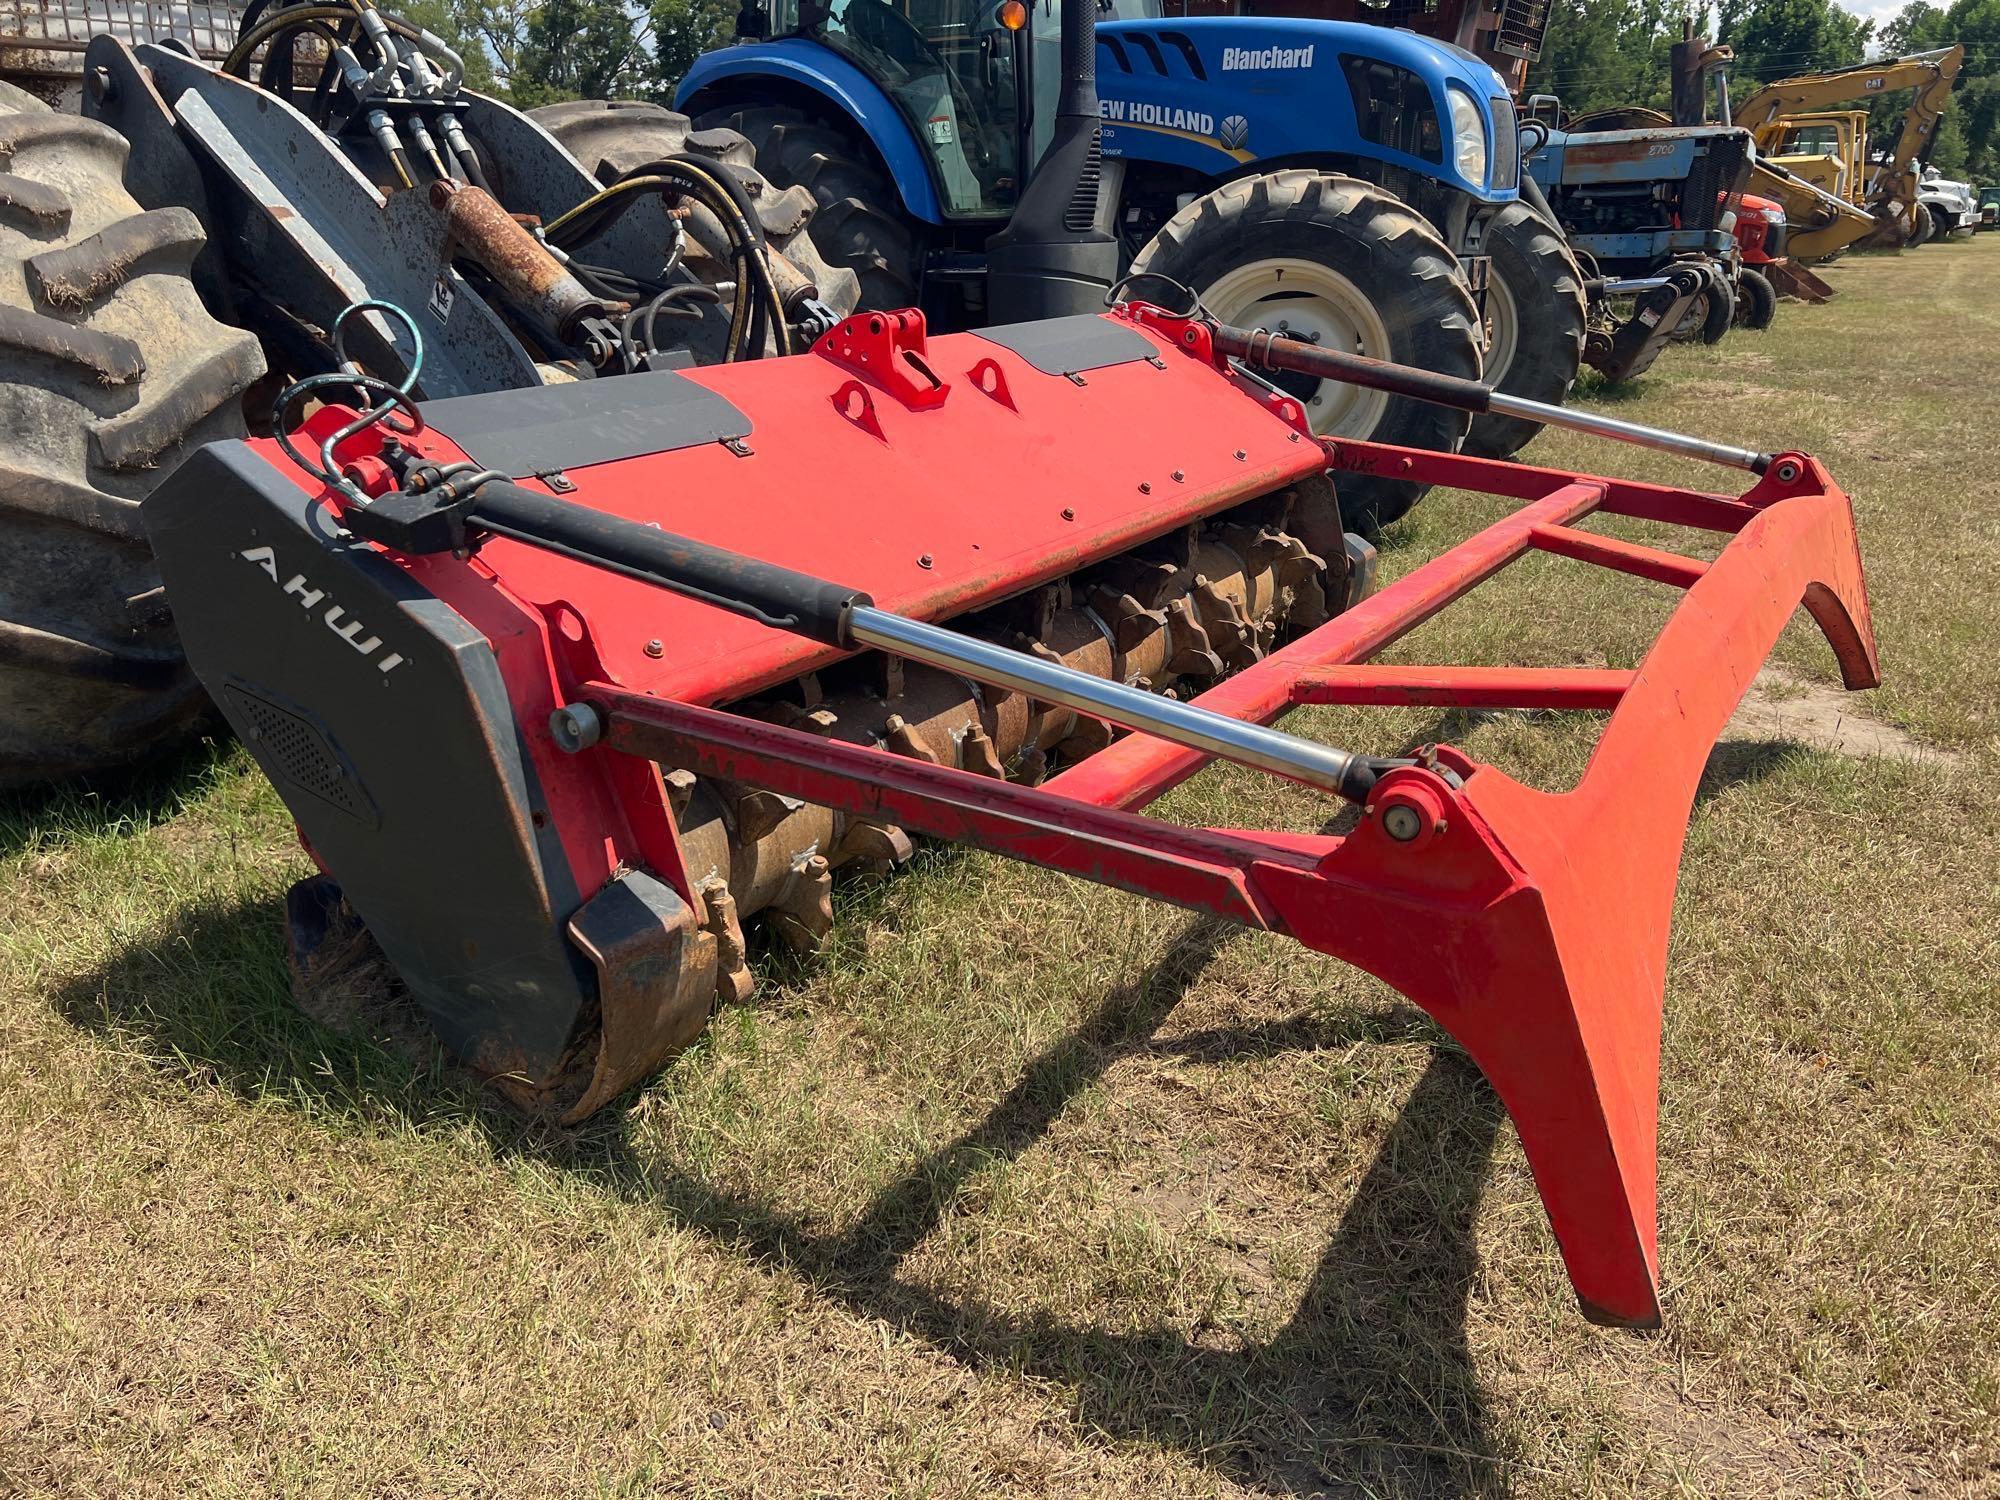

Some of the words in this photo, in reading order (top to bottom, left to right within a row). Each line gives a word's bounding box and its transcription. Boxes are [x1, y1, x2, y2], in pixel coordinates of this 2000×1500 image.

[1222, 44, 1315, 71] Blanchard
[1865, 79, 1882, 89] CAT
[1098, 99, 1125, 120] EW
[1129, 102, 1214, 135] HOLLAND
[1648, 144, 1675, 155] 8700
[240, 546, 404, 673] AHWI
